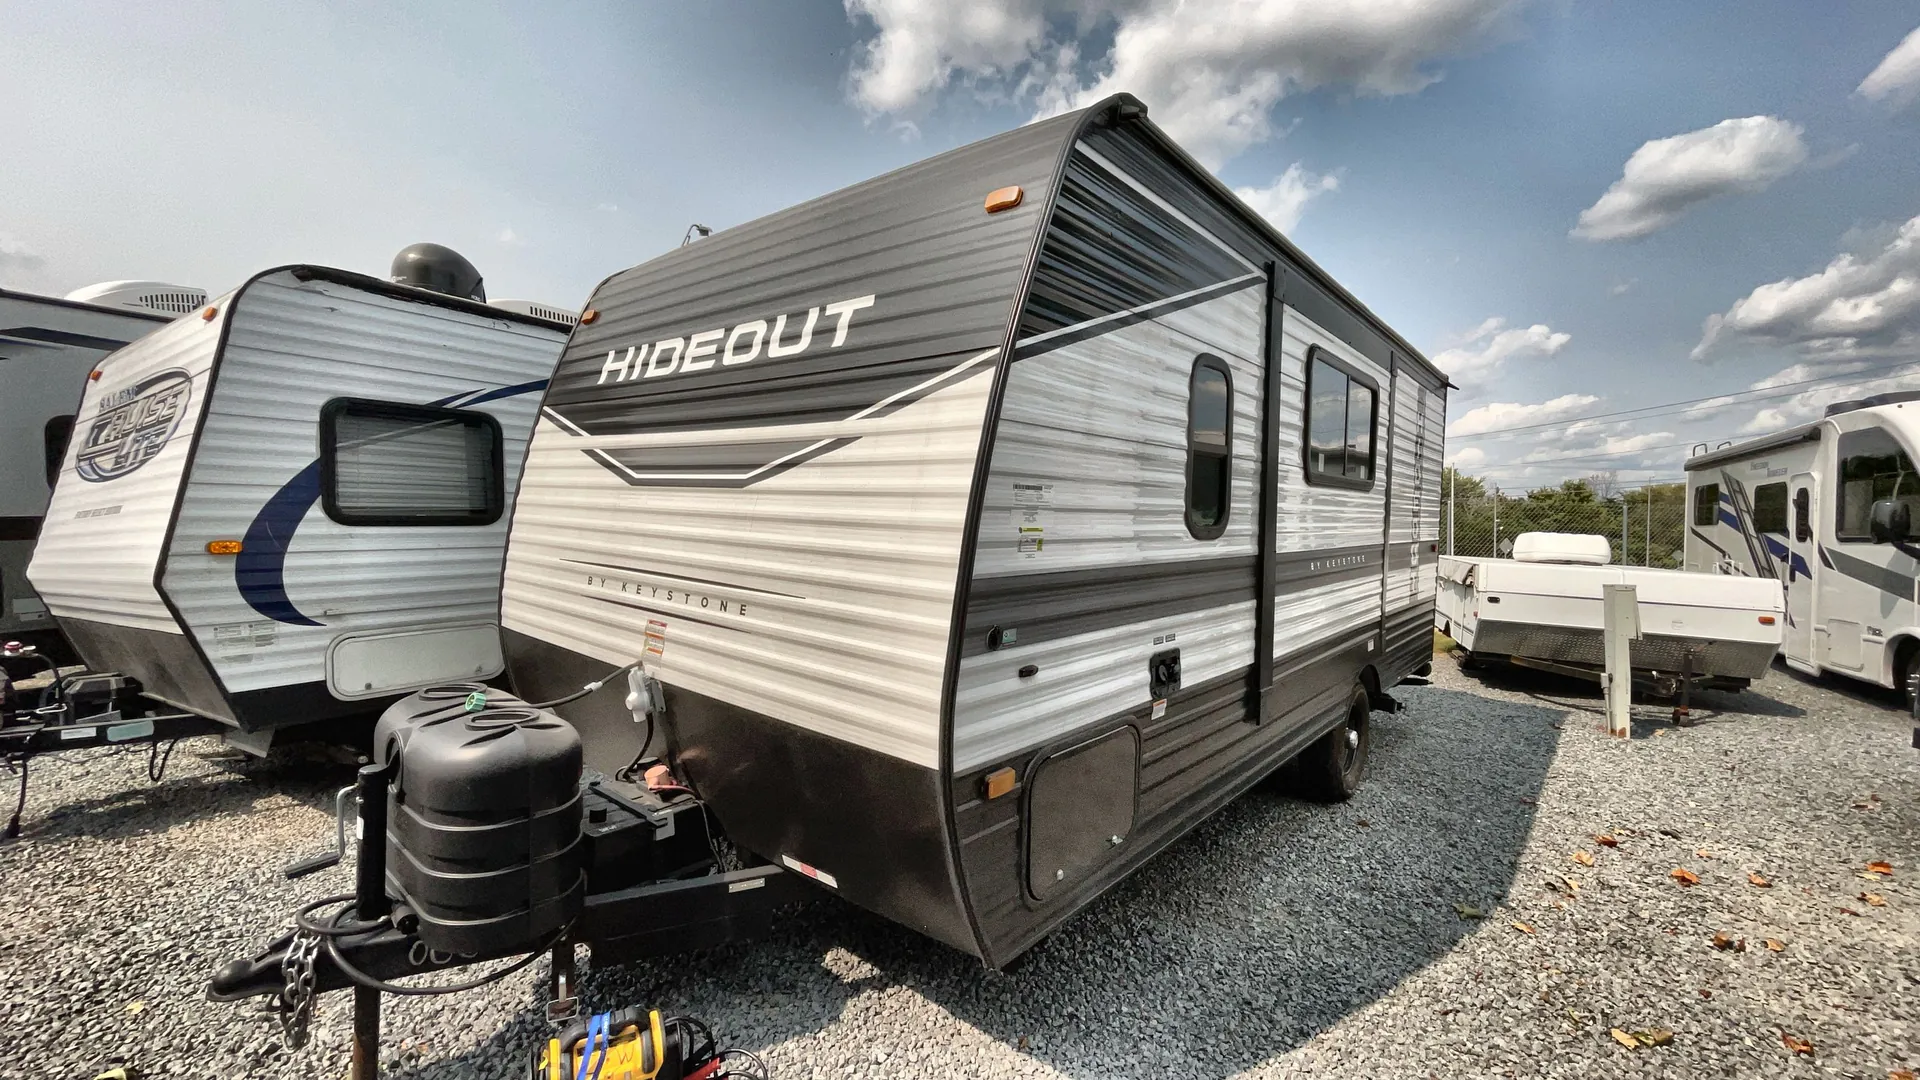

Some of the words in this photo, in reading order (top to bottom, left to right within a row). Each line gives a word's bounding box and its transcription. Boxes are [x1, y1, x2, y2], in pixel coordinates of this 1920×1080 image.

[597, 294, 876, 385] HIDEOUT
[587, 576, 606, 588] BY
[621, 581, 747, 616] KEYSTONE
